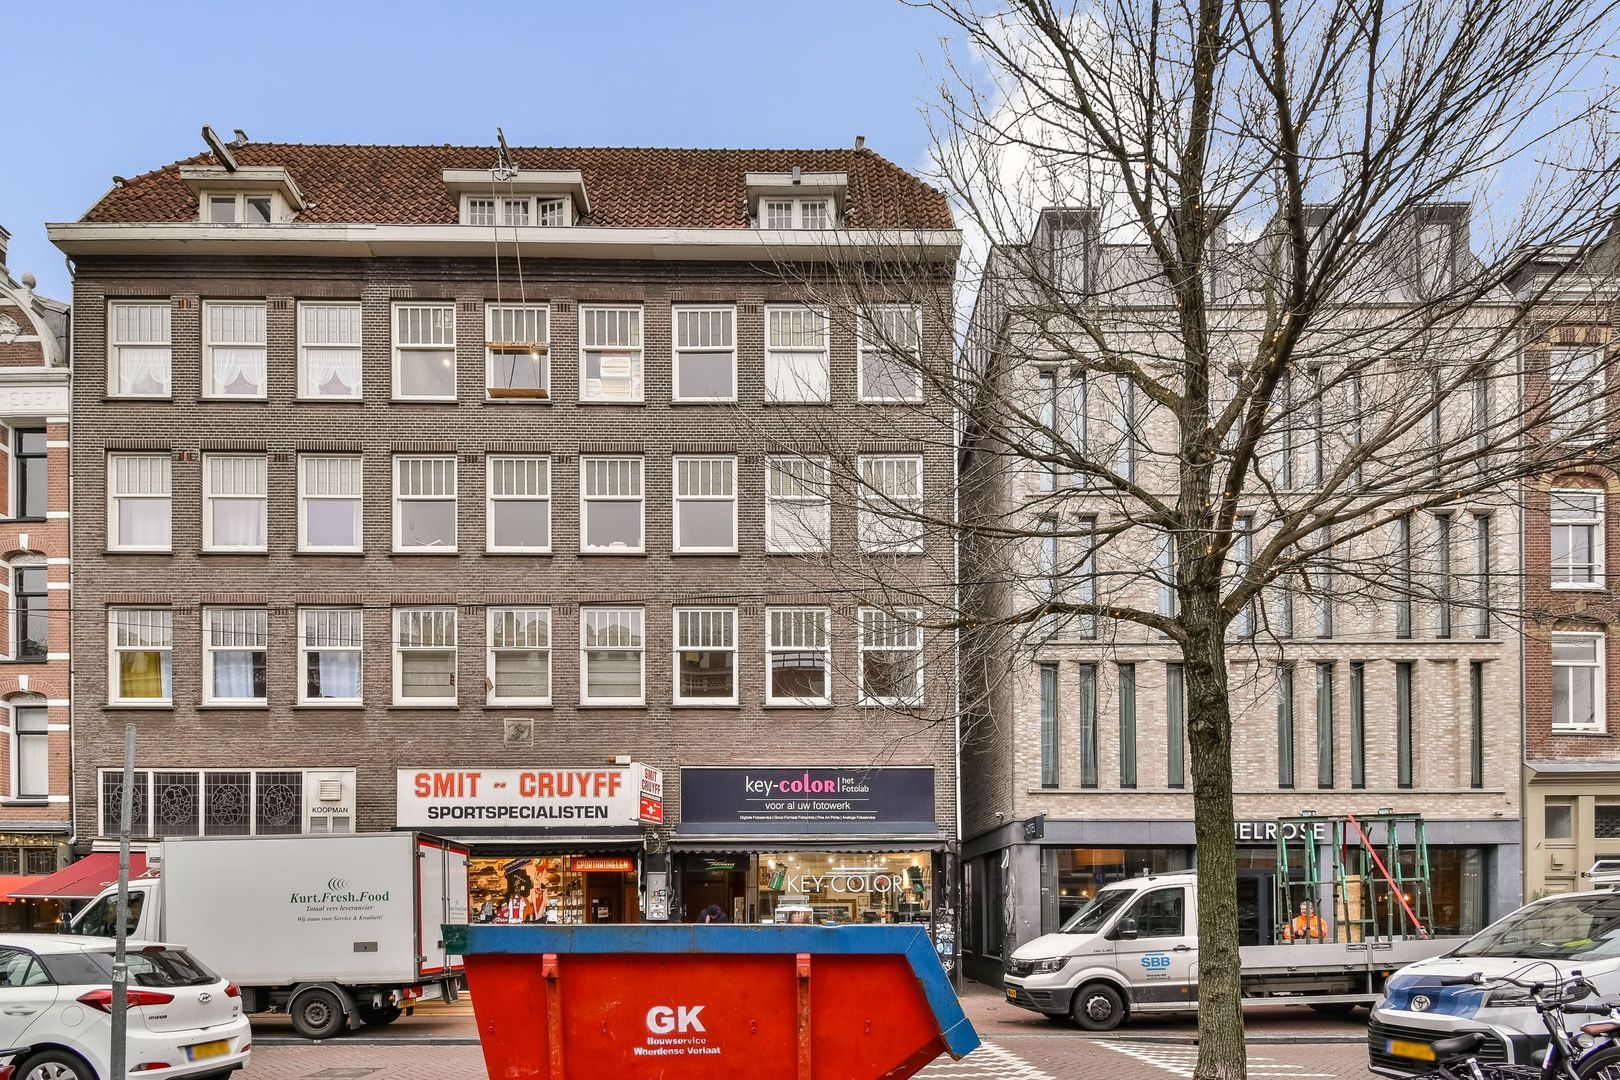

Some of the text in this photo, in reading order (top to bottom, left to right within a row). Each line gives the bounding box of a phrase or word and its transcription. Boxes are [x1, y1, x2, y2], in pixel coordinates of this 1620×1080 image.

[645, 768, 657, 783] SMIT
[841, 777, 855, 785] het
[414, 772, 481, 798] SMIT
[519, 772, 622, 798] CRUYFF
[641, 779, 661, 795] CRUYFF
[745, 773, 836, 797] key-color
[841, 785, 869, 793] Fotolab
[427, 805, 608, 819] SPORTSPECIALISTEN
[787, 801, 795, 810] al
[812, 801, 851, 810] fotowerk
[1235, 822, 1325, 839] ELROSE
[576, 860, 628, 869] SPORTARTIKELEN
[787, 875, 903, 893] KEY-COLOR
[290, 891, 390, 903] Kurt.Fresh.Food
[1140, 957, 1171, 967] SBB
[646, 1005, 706, 1034] GK
[647, 1037, 707, 1045] Bouwservice
[687, 1046, 721, 1055] Verlaat
